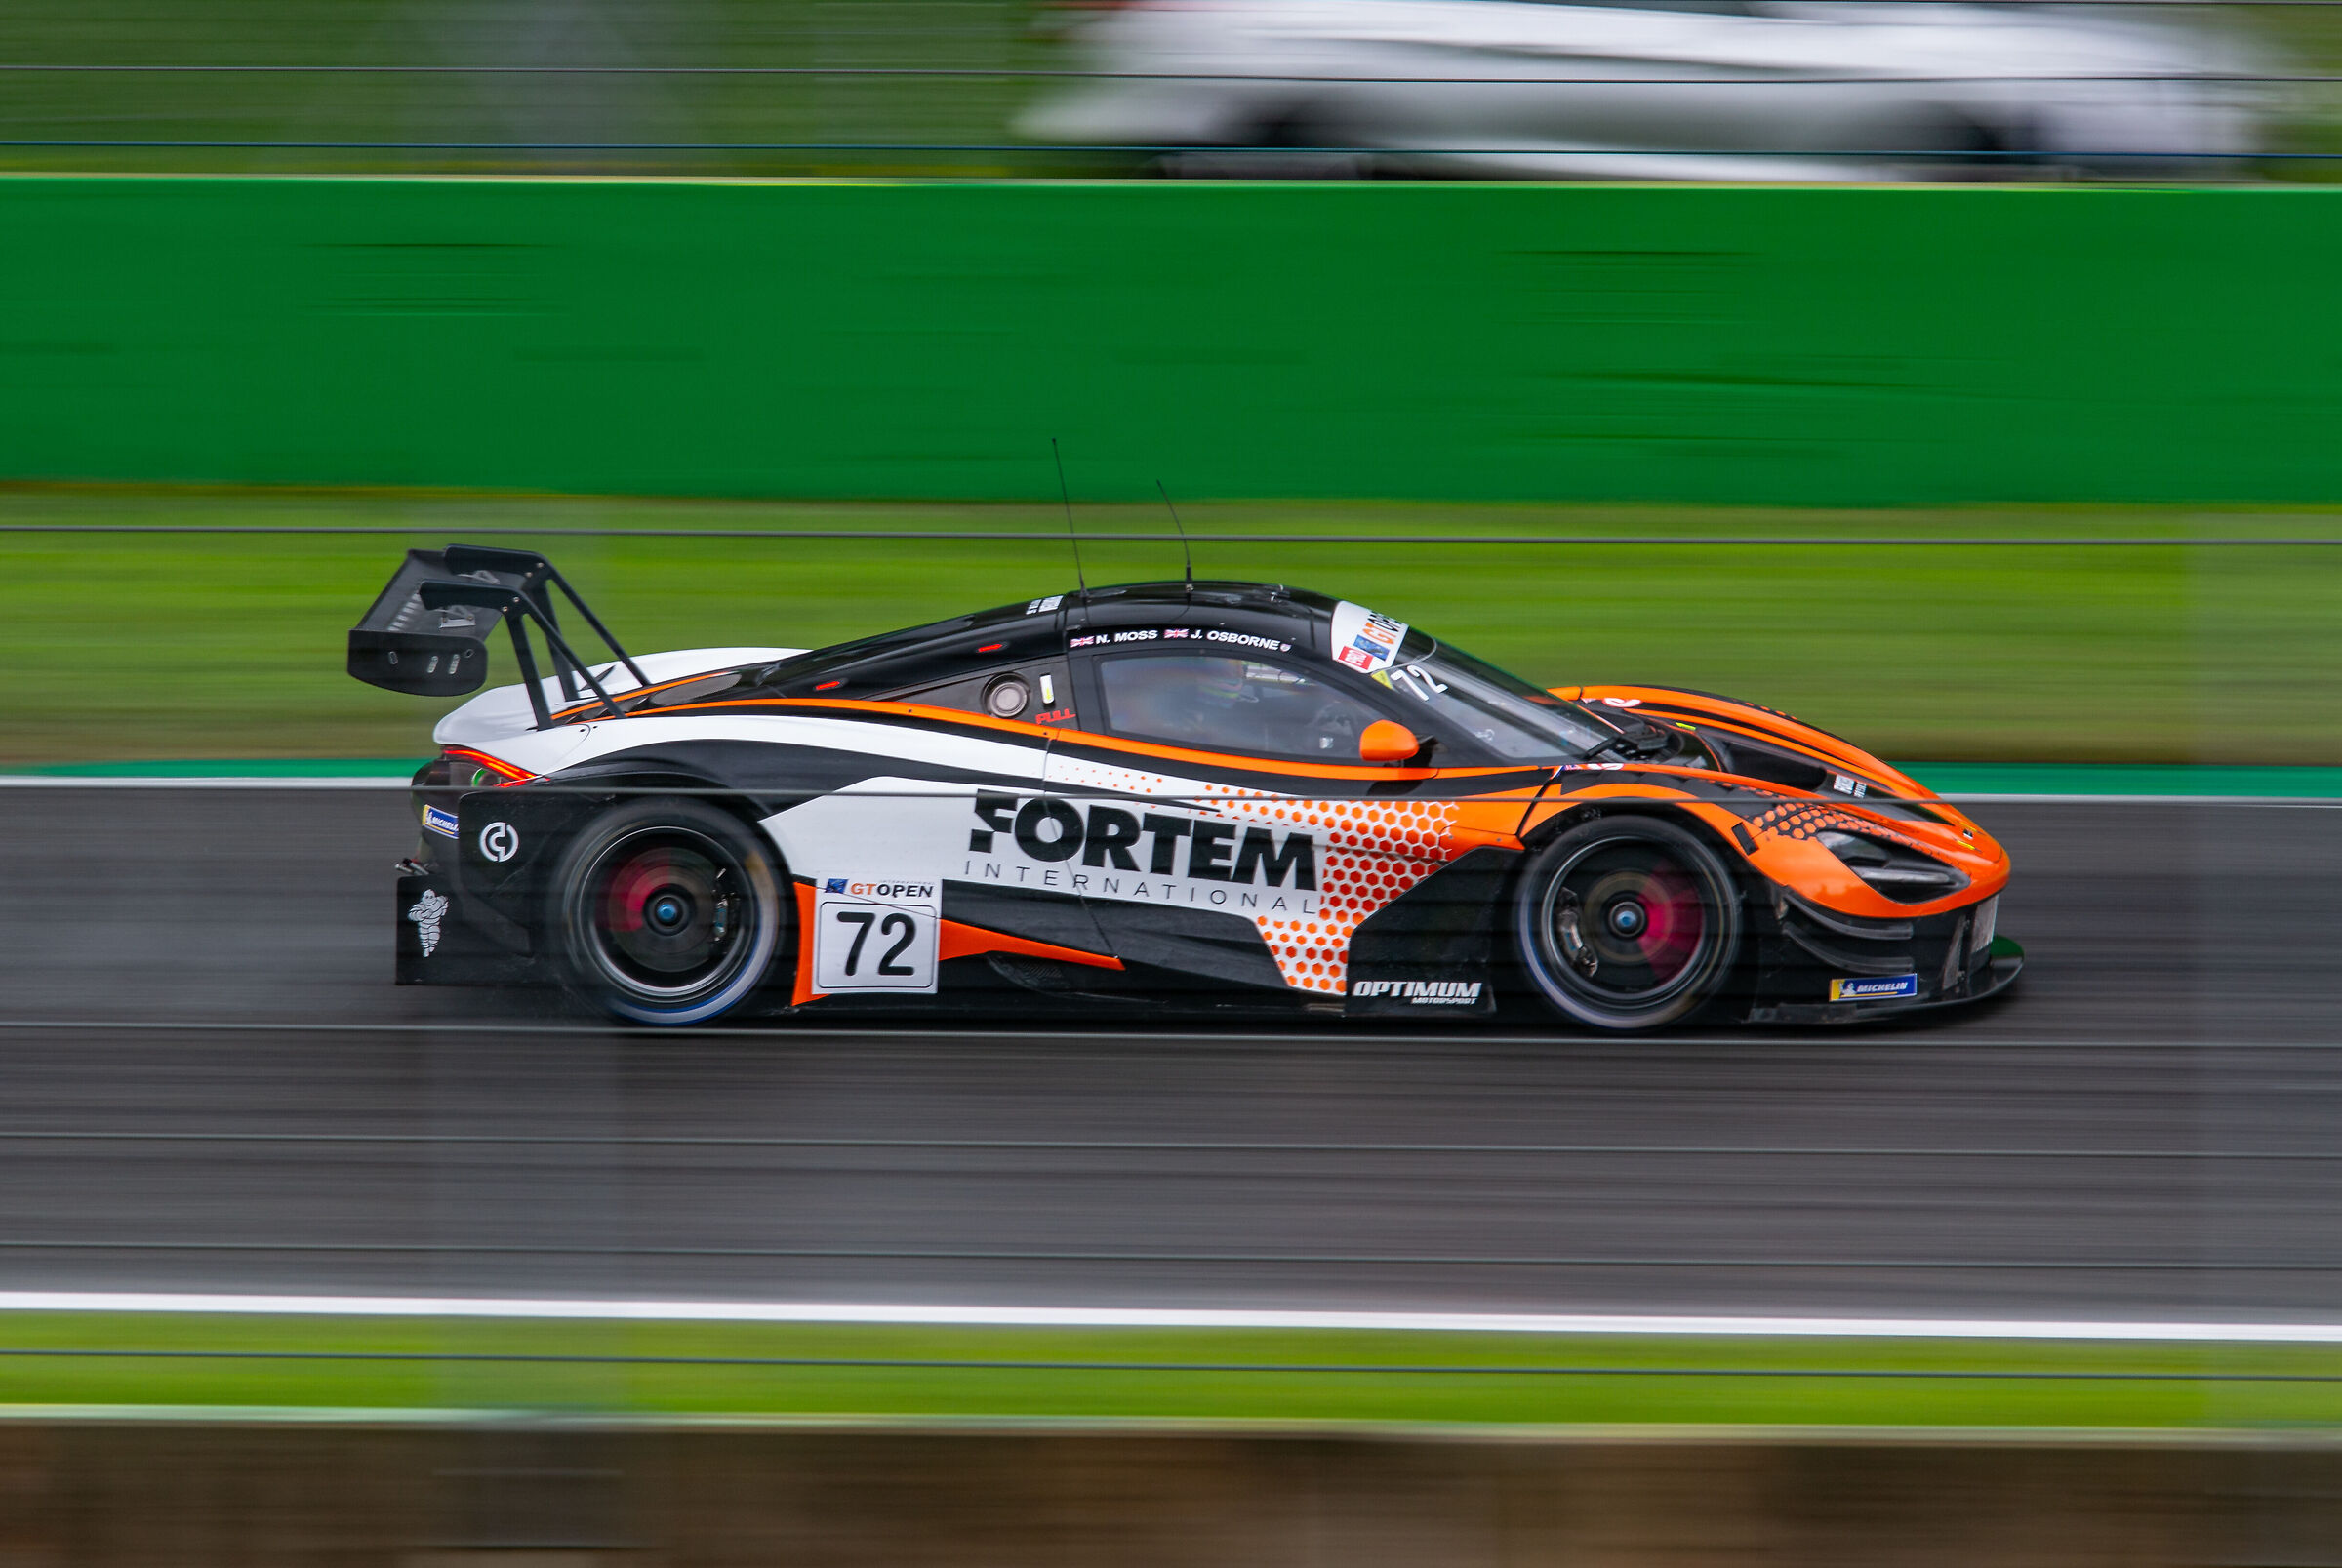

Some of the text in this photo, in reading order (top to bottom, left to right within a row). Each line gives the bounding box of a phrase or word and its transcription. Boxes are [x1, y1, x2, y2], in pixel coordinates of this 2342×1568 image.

[1095, 630, 1158, 644] N. MOSS
[1191, 629, 1280, 651] J. OSBORNE
[1390, 664, 1448, 701] 72
[1035, 707, 1076, 725] PULL
[969, 789, 1317, 892] FORTEM
[964, 860, 1317, 915] INTERNATIONAL
[836, 911, 916, 977] 72
[1352, 981, 1482, 997] OPTIMUM
[1856, 982, 1909, 993] MICHELIN
